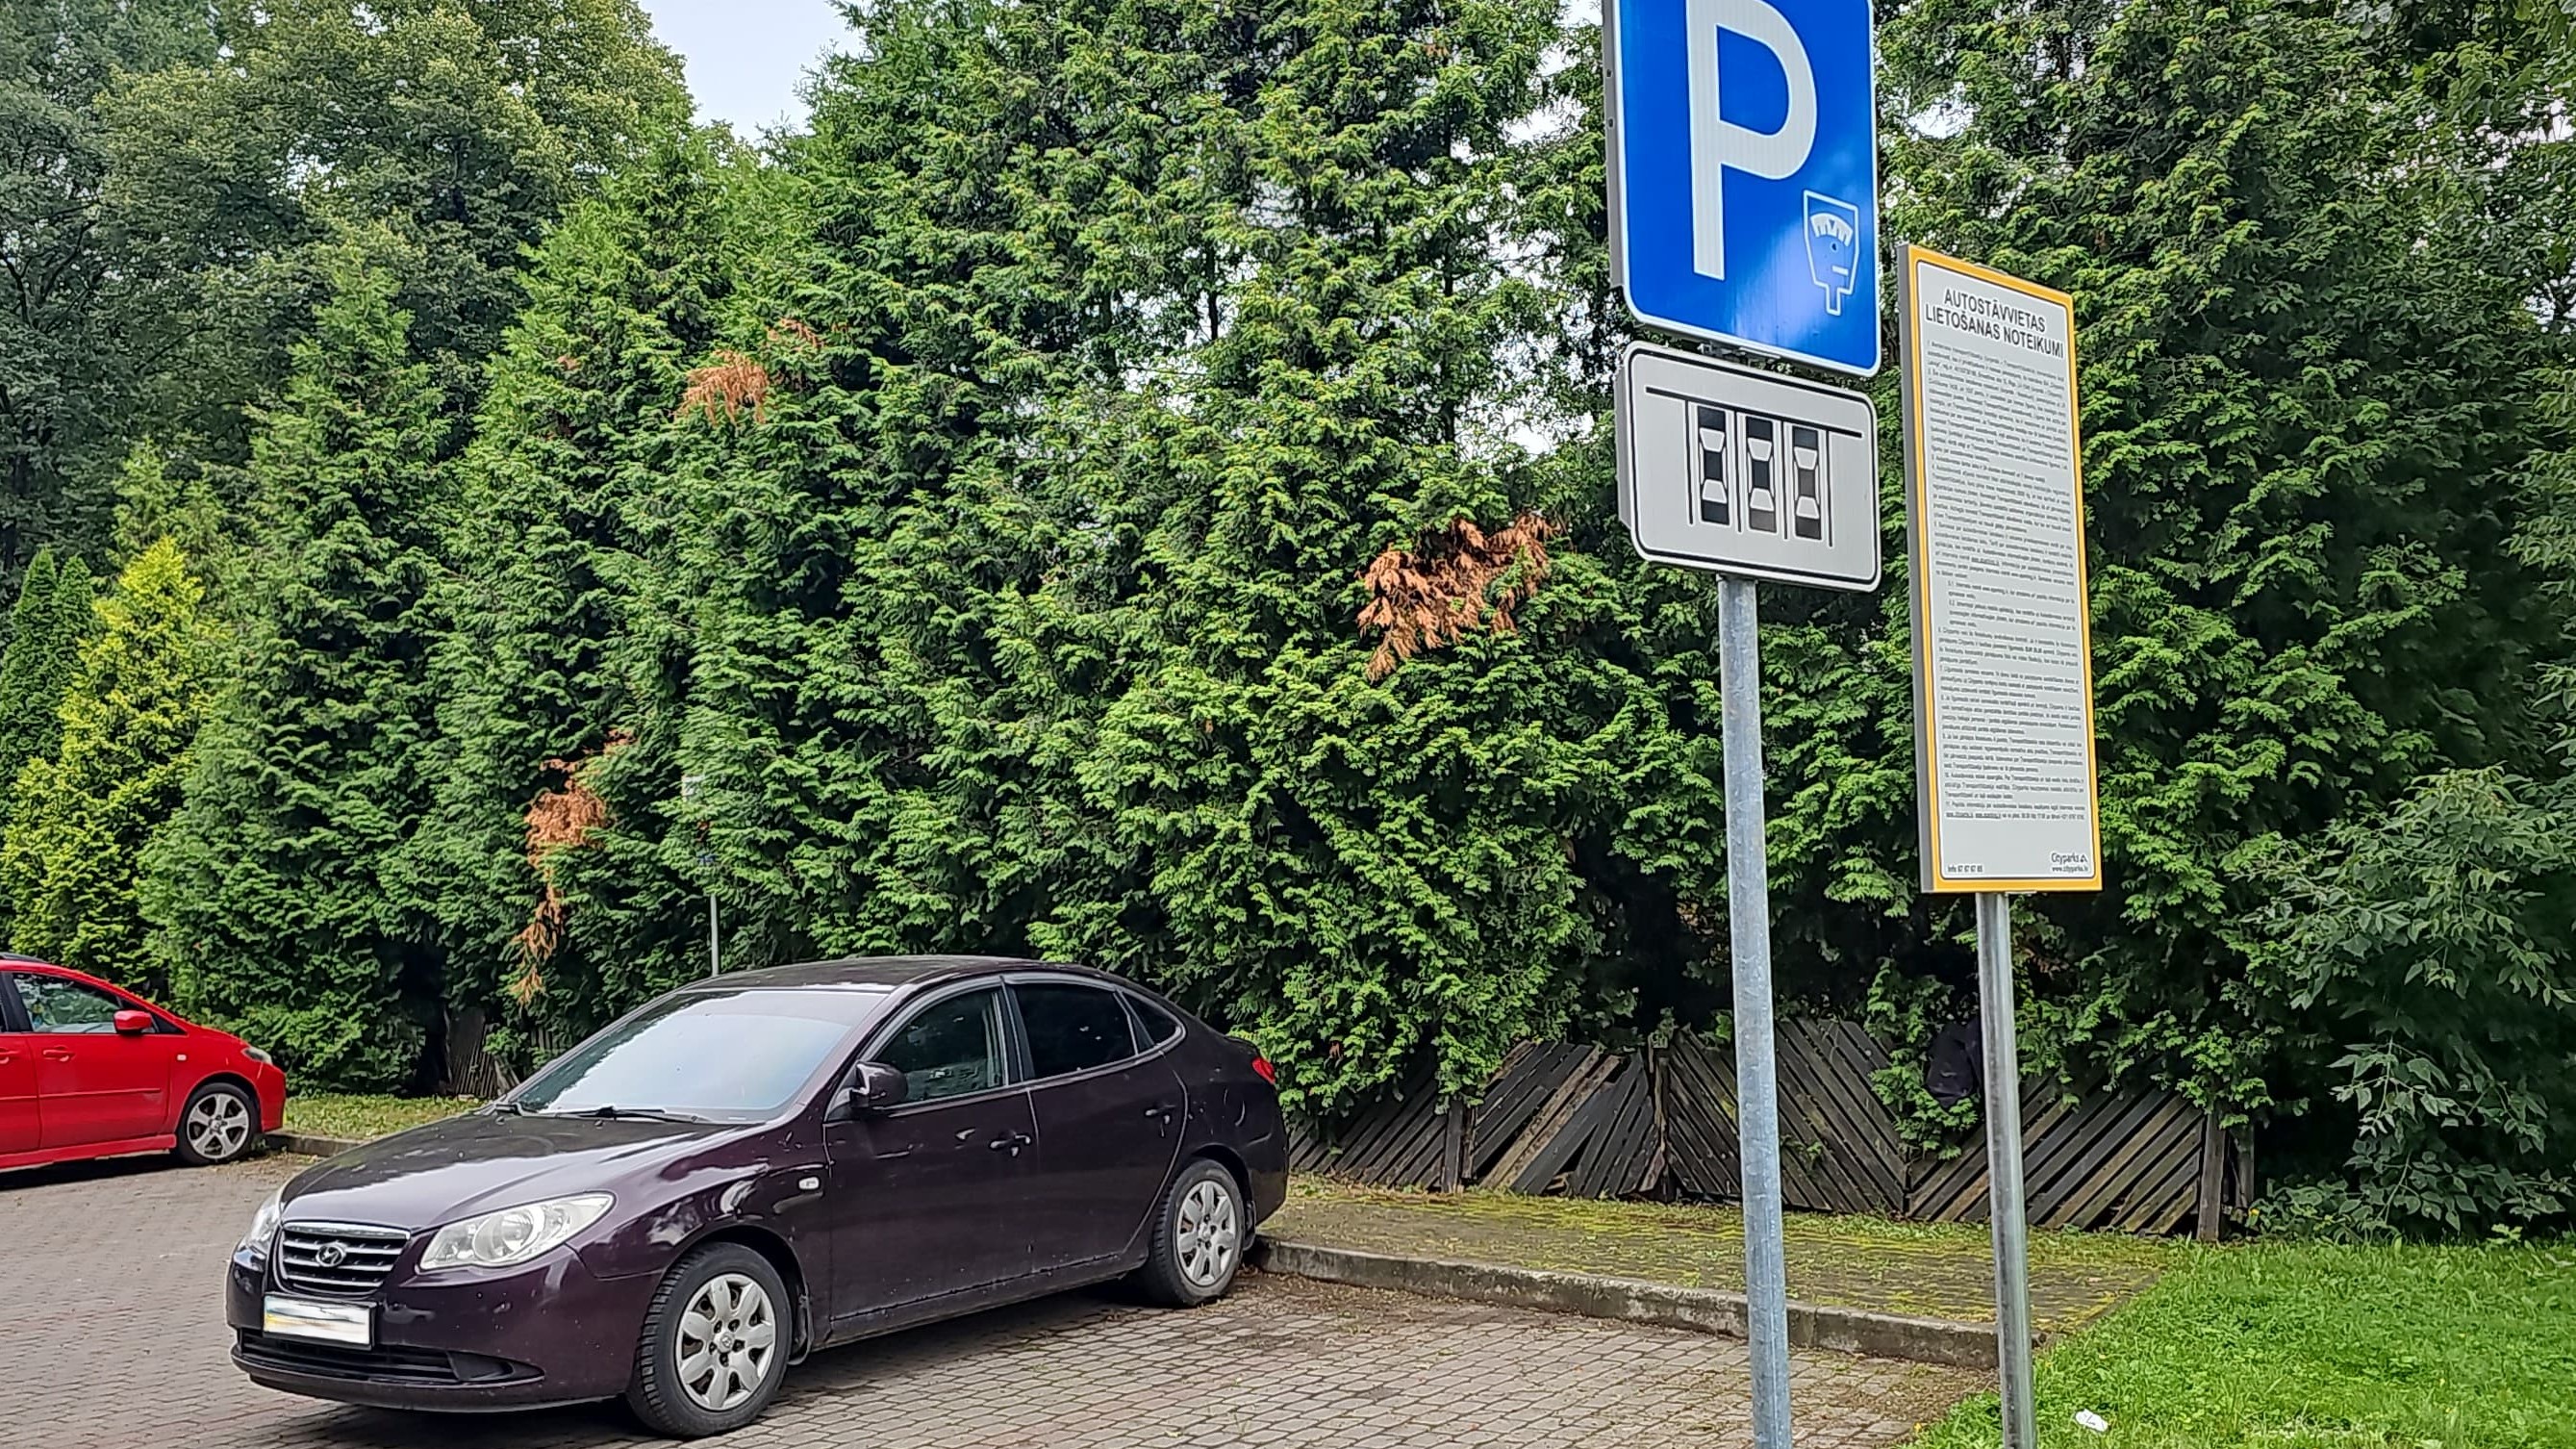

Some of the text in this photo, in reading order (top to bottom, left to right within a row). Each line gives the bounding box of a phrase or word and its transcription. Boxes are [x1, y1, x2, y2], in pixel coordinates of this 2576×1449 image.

[1686, 0, 1817, 280] P
[1925, 304, 2064, 359] LIETOŠANAS NOTEIKUMI
[1944, 289, 2046, 333] AUTOSTĀVVIETAS
